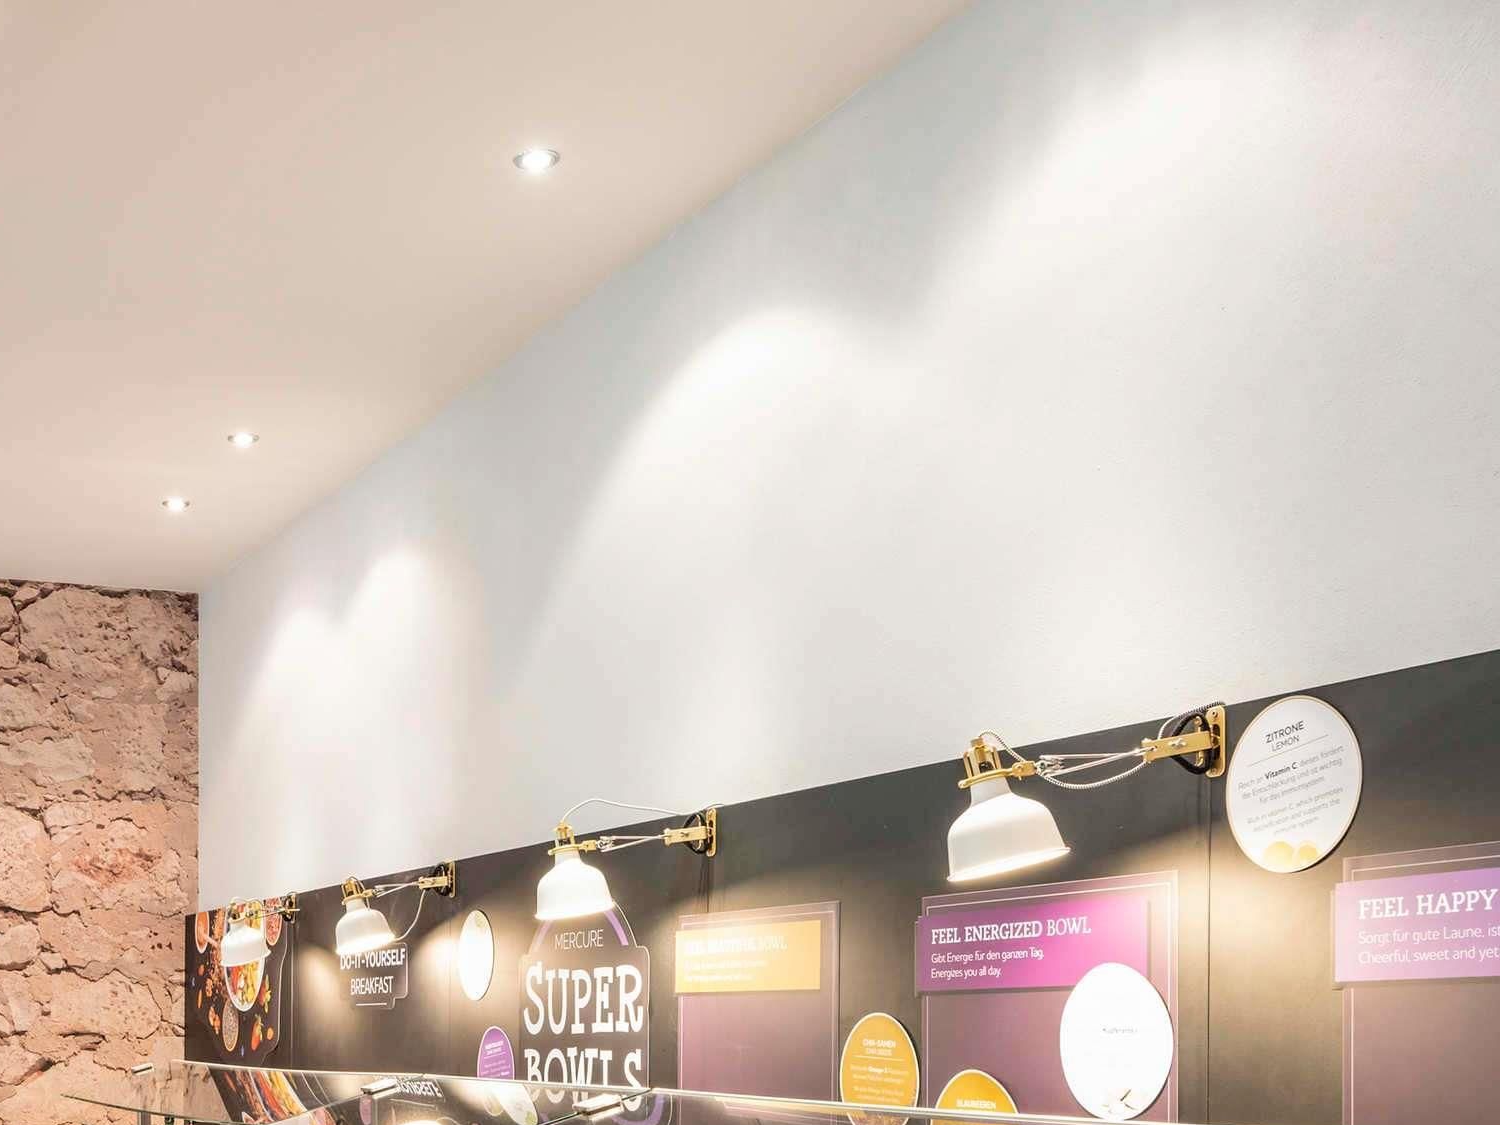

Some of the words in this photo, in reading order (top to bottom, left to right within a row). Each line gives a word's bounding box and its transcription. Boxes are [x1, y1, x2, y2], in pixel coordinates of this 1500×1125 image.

[1265, 720, 1305, 744] ZITRONE
[1271, 735, 1300, 752] LEMON
[1264, 766, 1291, 780] Vitamin
[1358, 896, 1409, 920] FEEL
[1416, 888, 1499, 916] HAPPY
[555, 929, 604, 949] MERCURE
[931, 927, 962, 945] FEEL
[964, 920, 1043, 942] ENERGIZED
[1047, 916, 1092, 937] BOWL
[1412, 928, 1440, 945] gute
[340, 948, 406, 970] DO-IT-YOURSELF
[931, 953, 946, 964] Gibt
[986, 950, 1001, 961] den
[1001, 950, 1028, 962] ganzen
[1412, 950, 1450, 962] sweet
[1452, 946, 1476, 961] and
[1479, 947, 1499, 962] yet
[931, 967, 964, 981] Energizes
[964, 969, 978, 980] you
[979, 965, 987, 977] all
[351, 976, 394, 996] BREAKFAST
[523, 961, 644, 1035] SUPER
